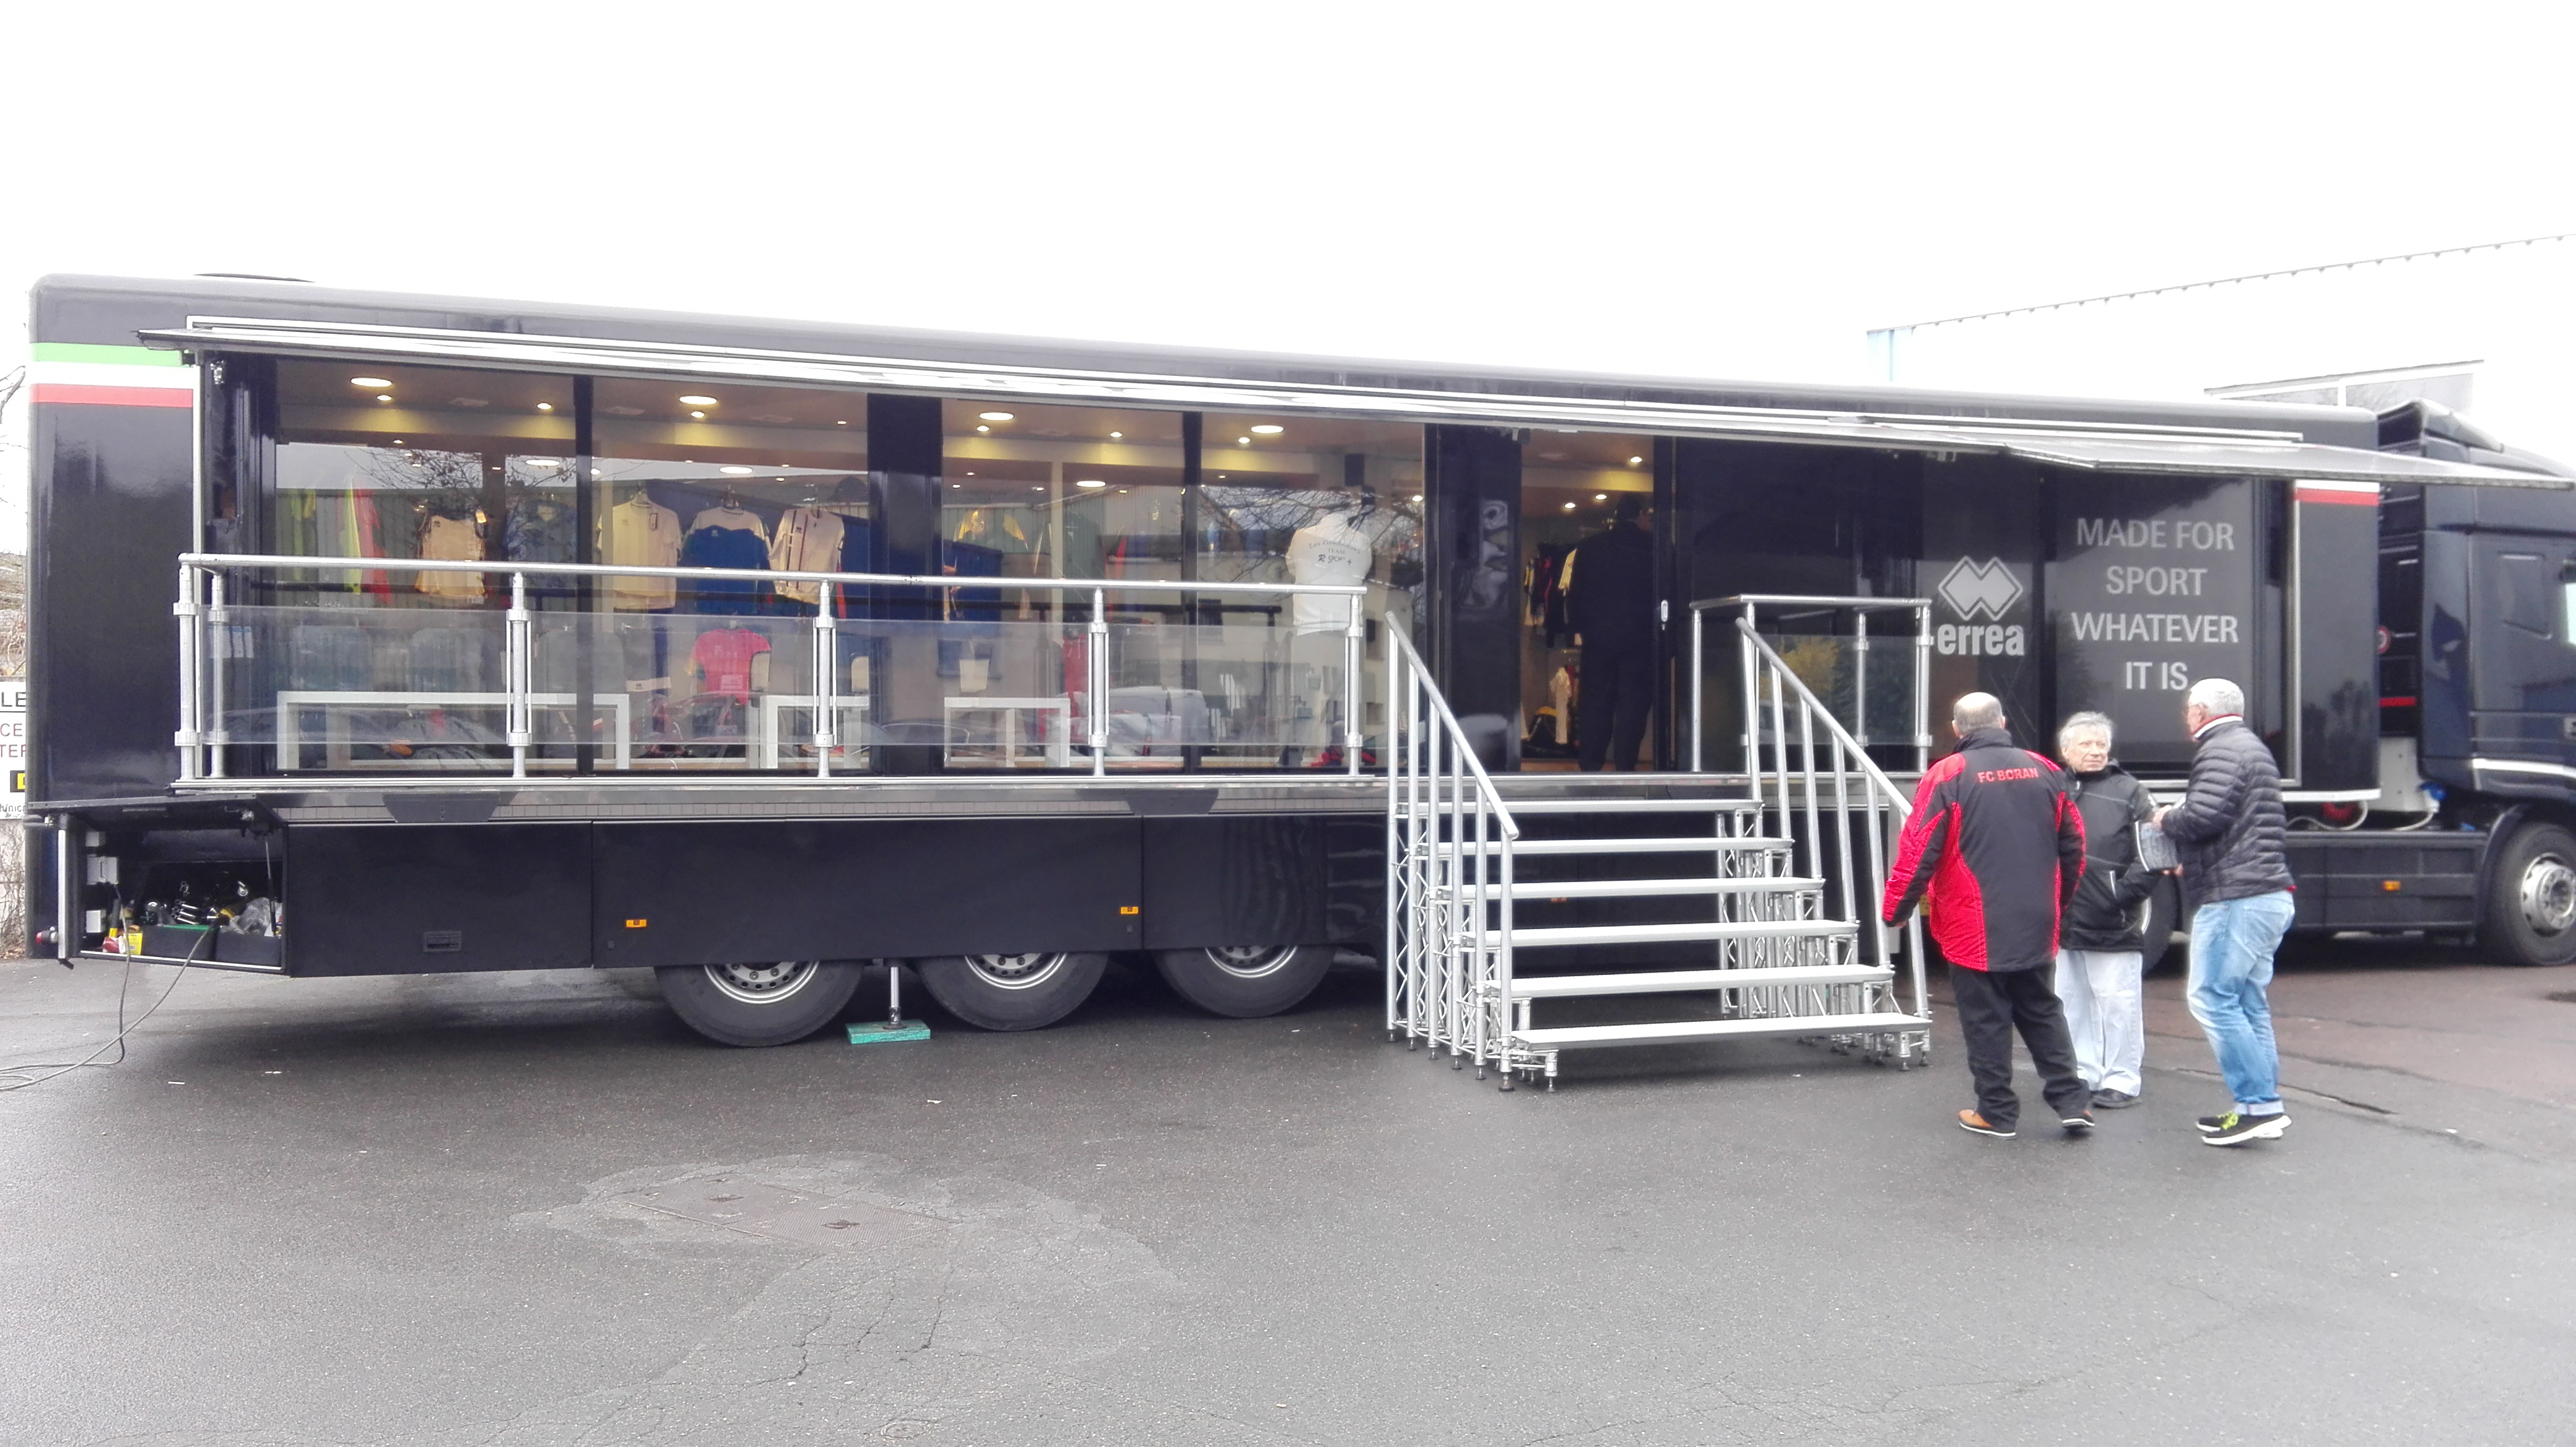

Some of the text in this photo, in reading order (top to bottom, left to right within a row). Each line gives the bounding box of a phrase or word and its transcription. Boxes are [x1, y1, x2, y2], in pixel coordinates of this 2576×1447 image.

[2077, 518, 2235, 550] MADE FOR
[2106, 567, 2208, 596] SPORT
[1938, 624, 2024, 655] errea
[2071, 612, 2239, 643] WHATEVER
[2126, 662, 2188, 690] IT IS
[0, 724, 22, 737] CE
[1977, 768, 2039, 783] FC BORAN
